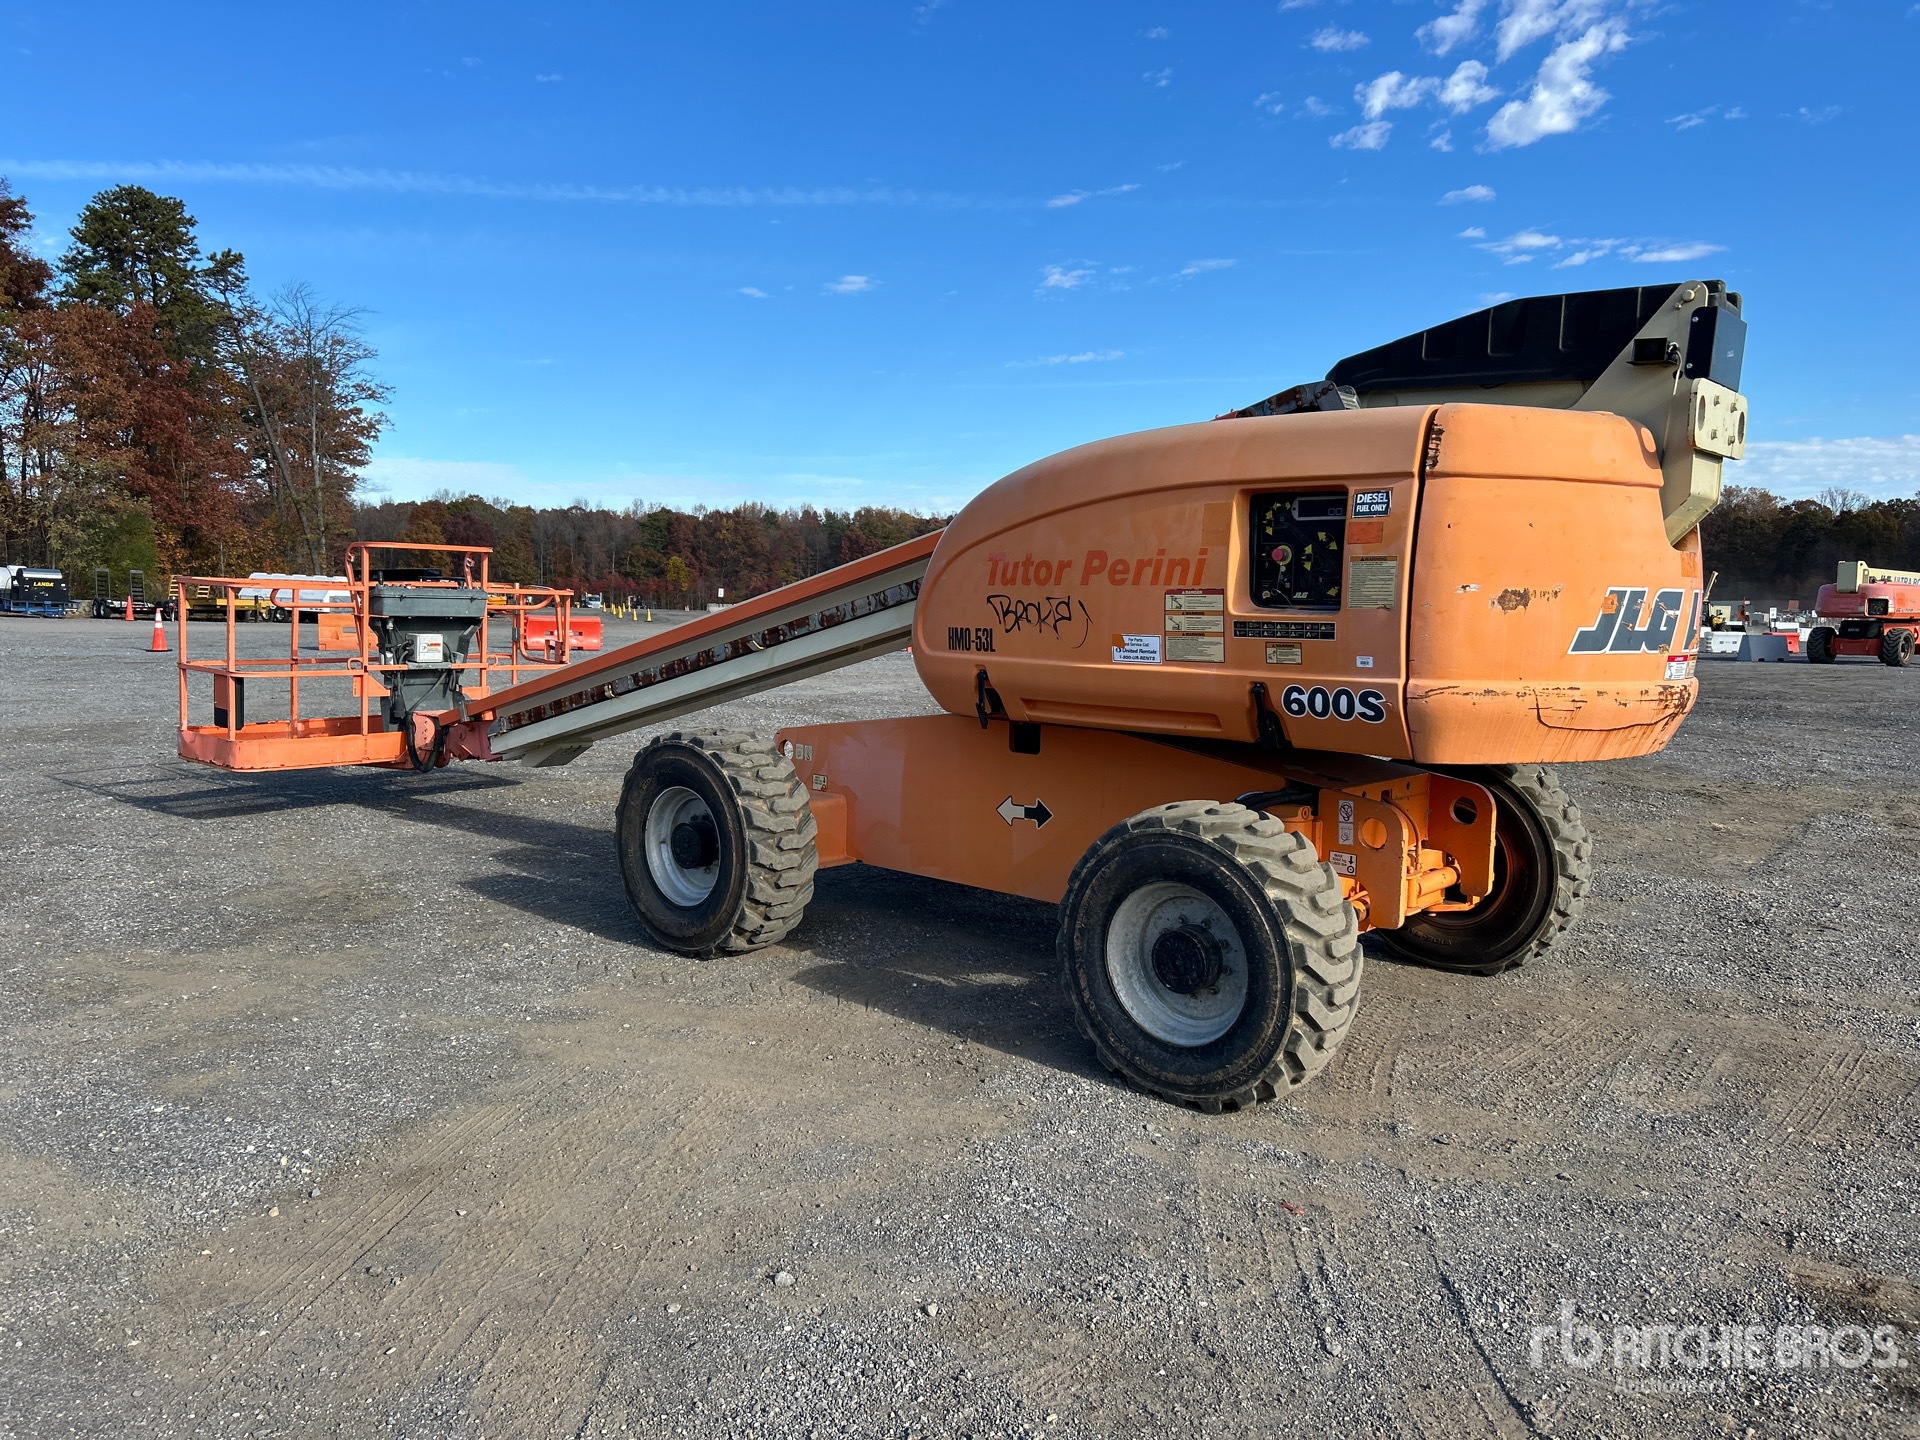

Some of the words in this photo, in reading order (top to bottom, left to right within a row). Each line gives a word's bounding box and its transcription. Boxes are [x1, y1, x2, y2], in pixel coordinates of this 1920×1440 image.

[1356, 492, 1388, 504] DIESEL
[1356, 504, 1370, 513] FUEL
[1370, 503, 1387, 512] ONLY
[987, 552, 1073, 586] Tutor
[1080, 548, 1209, 587] Perini
[1567, 586, 1686, 655] JLG
[1281, 684, 1387, 724] 600S
